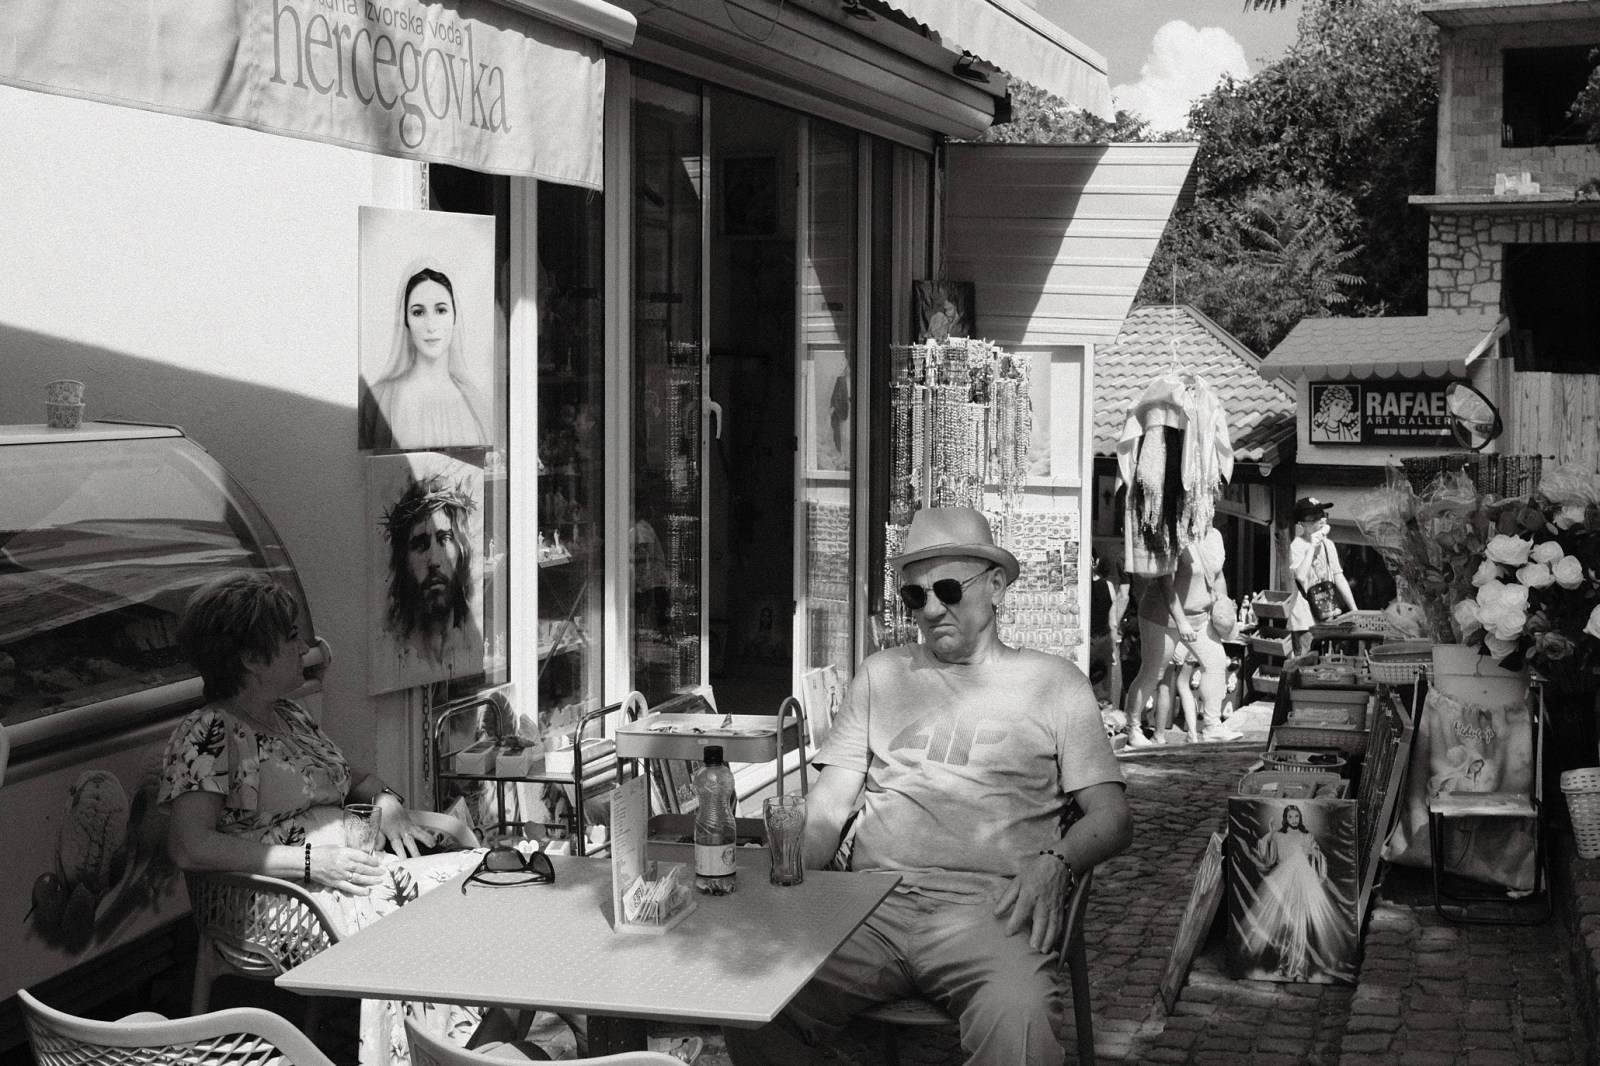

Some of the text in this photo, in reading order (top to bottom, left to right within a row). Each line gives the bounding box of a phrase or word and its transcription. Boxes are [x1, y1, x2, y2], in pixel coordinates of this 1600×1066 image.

[427, 20, 463, 46] voda
[269, 0, 512, 149] hercegovka
[1366, 416, 1391, 425] ART
